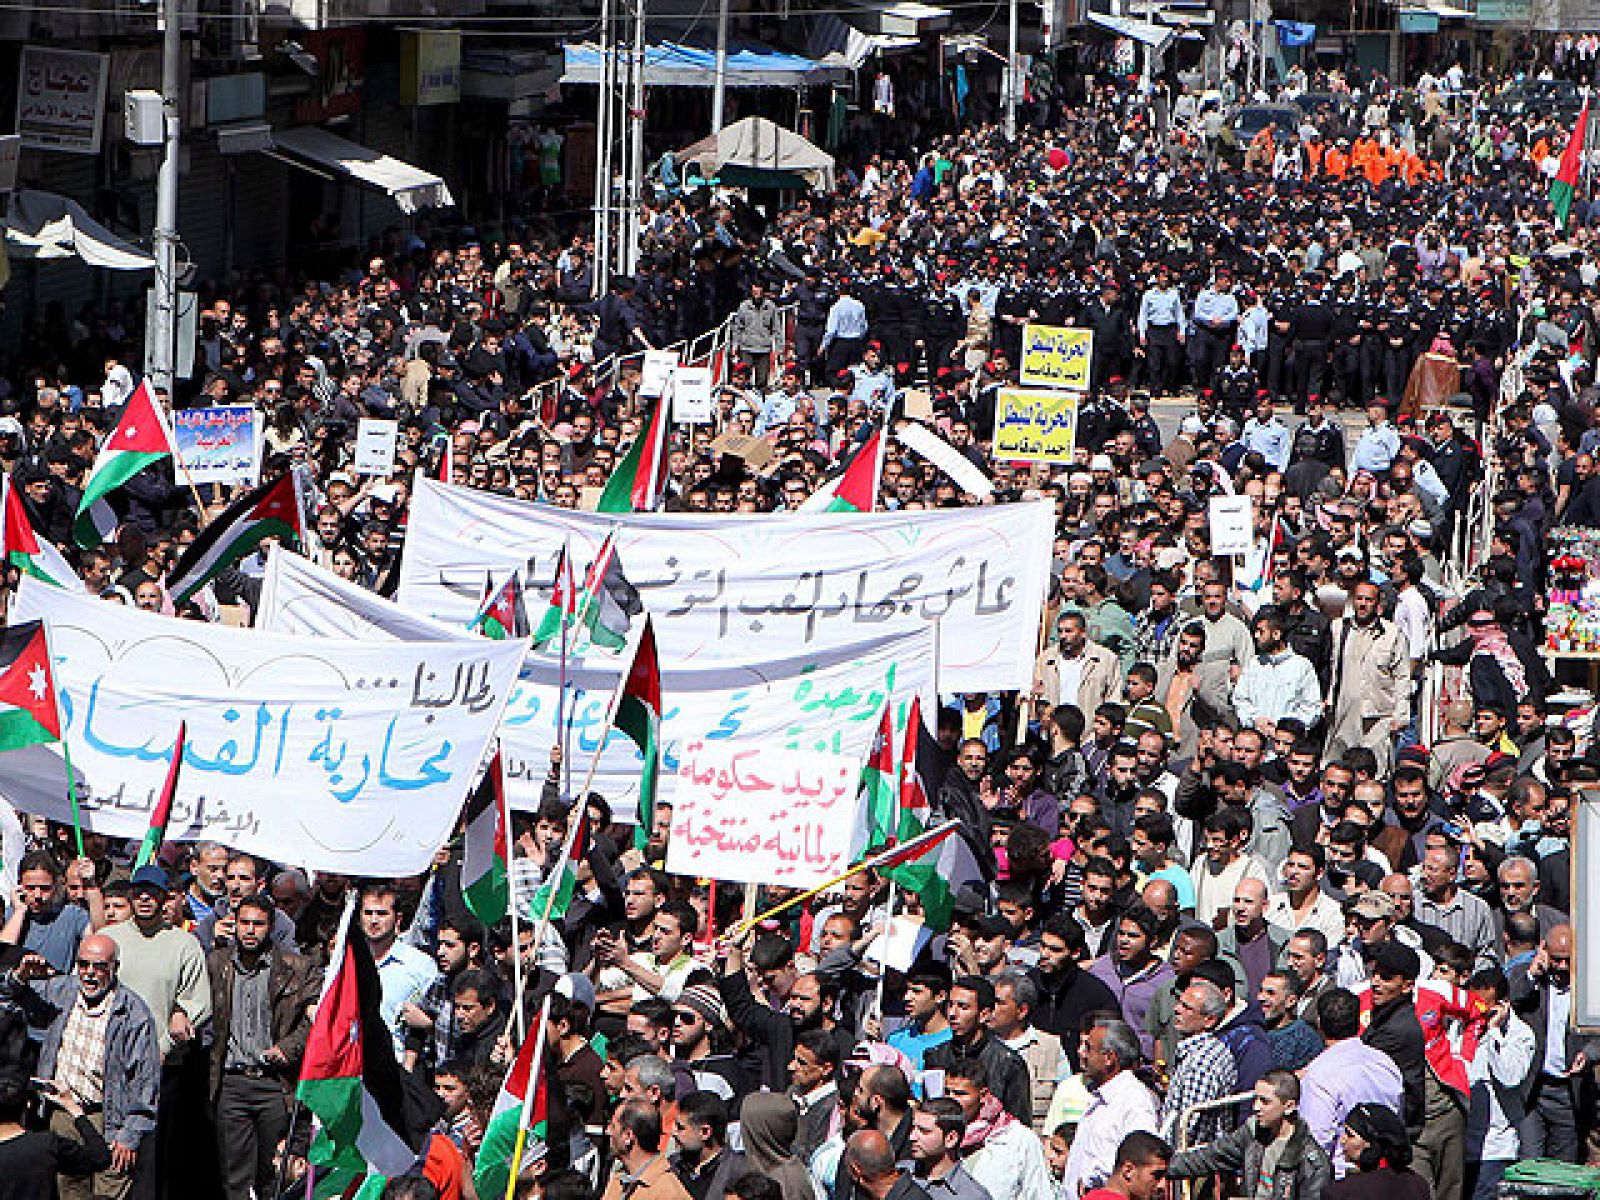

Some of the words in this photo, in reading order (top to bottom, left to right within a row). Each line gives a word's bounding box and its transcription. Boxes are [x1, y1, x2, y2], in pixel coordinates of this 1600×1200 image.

[822, 571, 923, 623] جهاد
[920, 556, 1016, 620] عاش
[307, 706, 453, 803] محاربة
[680, 741, 776, 801] حكومة
[782, 767, 848, 808] نريد
[673, 801, 761, 858] منتخبة
[763, 810, 842, 876] برلمانية
